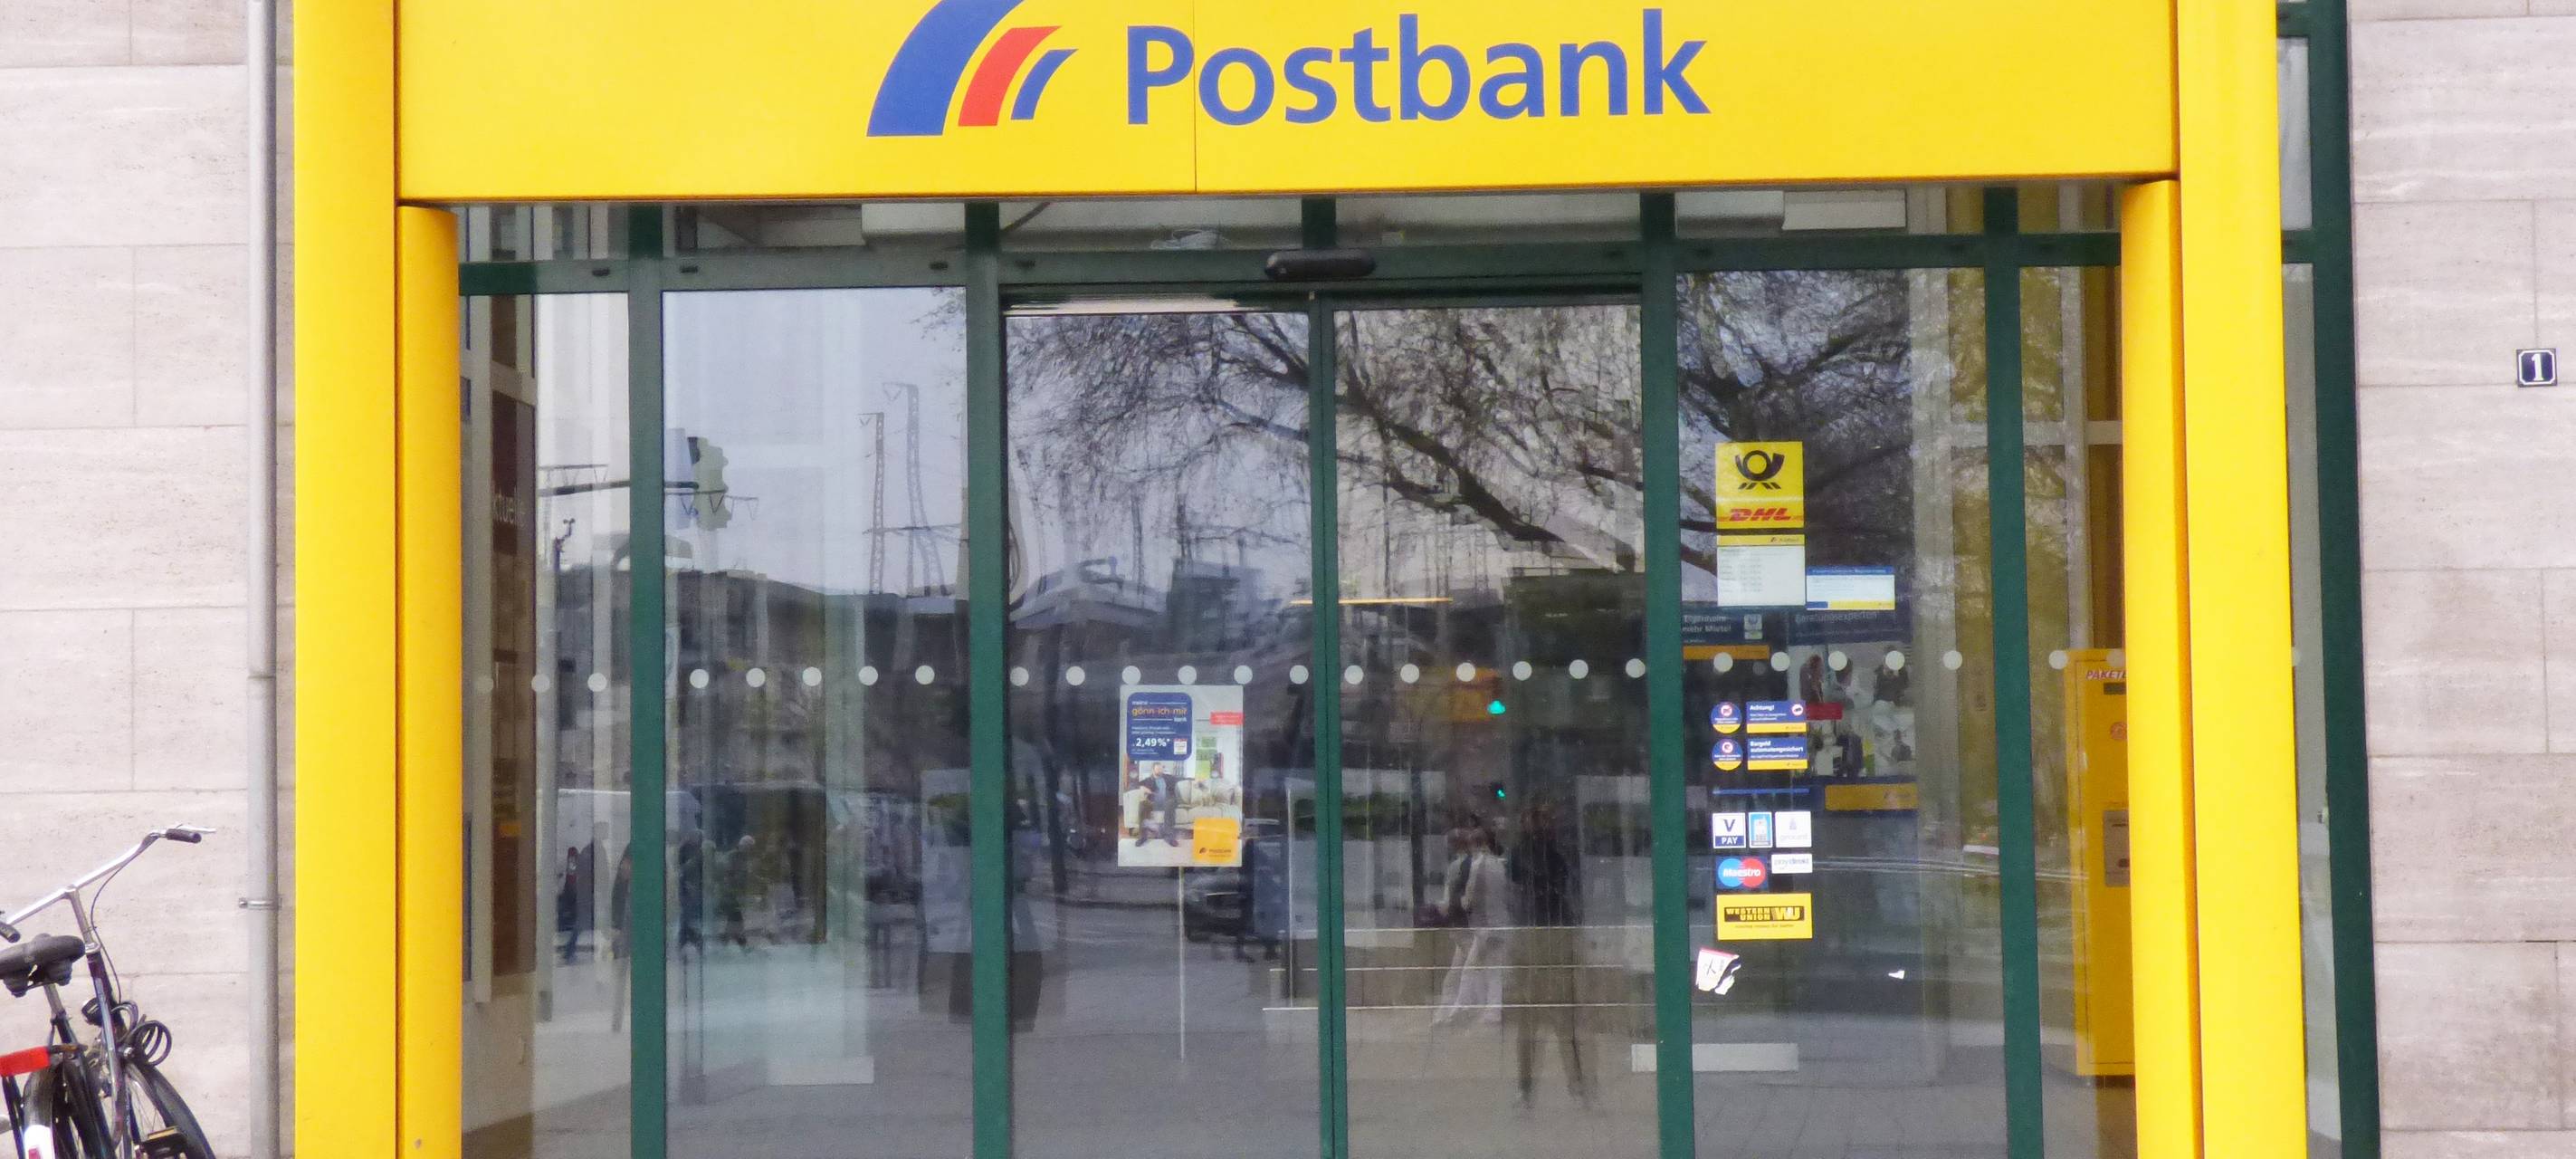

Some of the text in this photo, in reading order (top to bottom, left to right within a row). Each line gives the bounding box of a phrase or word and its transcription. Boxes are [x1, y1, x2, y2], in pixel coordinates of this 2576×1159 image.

[1126, 7, 1713, 126] Postbank
[2531, 353, 2544, 381] 1
[1729, 507, 1792, 522] DHL
[1722, 819, 1736, 833] V
[1721, 837, 1738, 845] PAY
[1722, 867, 1761, 877] Maestro
